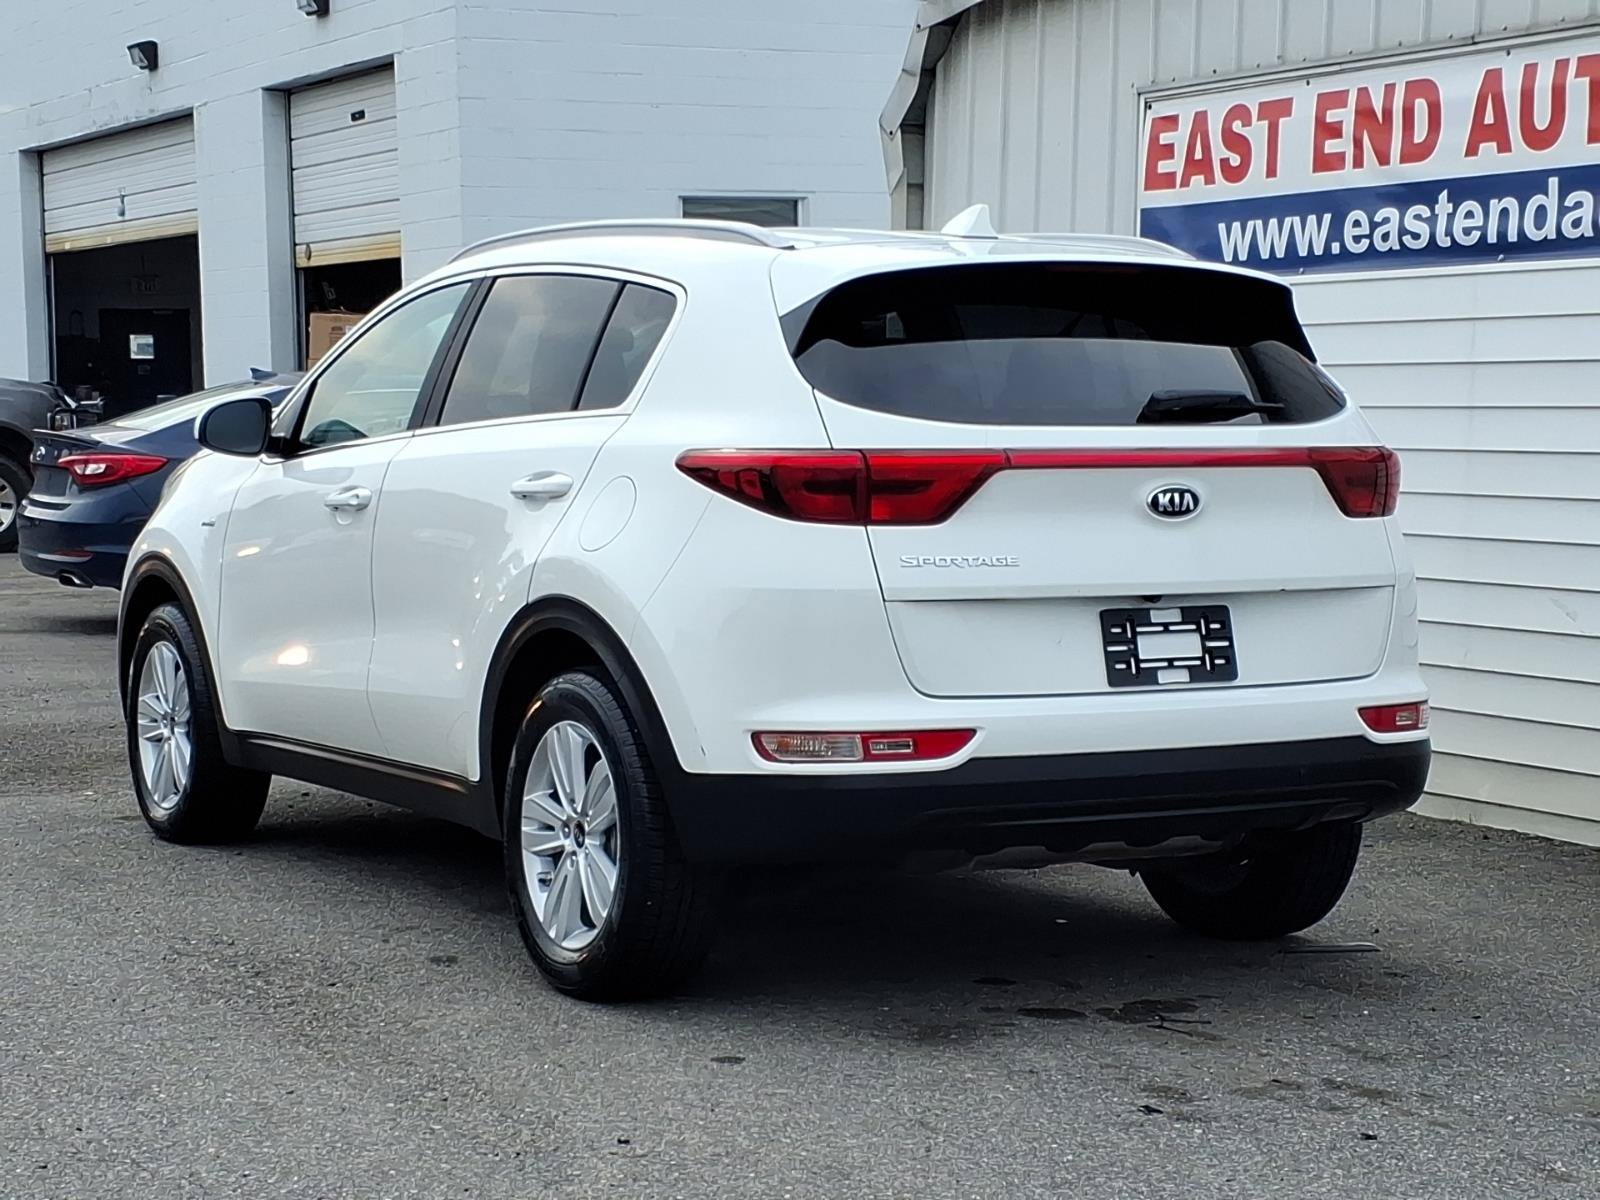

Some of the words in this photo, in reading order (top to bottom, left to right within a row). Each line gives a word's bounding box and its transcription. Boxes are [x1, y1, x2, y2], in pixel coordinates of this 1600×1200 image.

[1143, 97, 1294, 192] EAST
[1312, 77, 1442, 174] END
[1217, 176, 1600, 263] www.eastenda
[1158, 492, 1194, 511] KIA
[899, 555, 1020, 568] SPORTAGE
